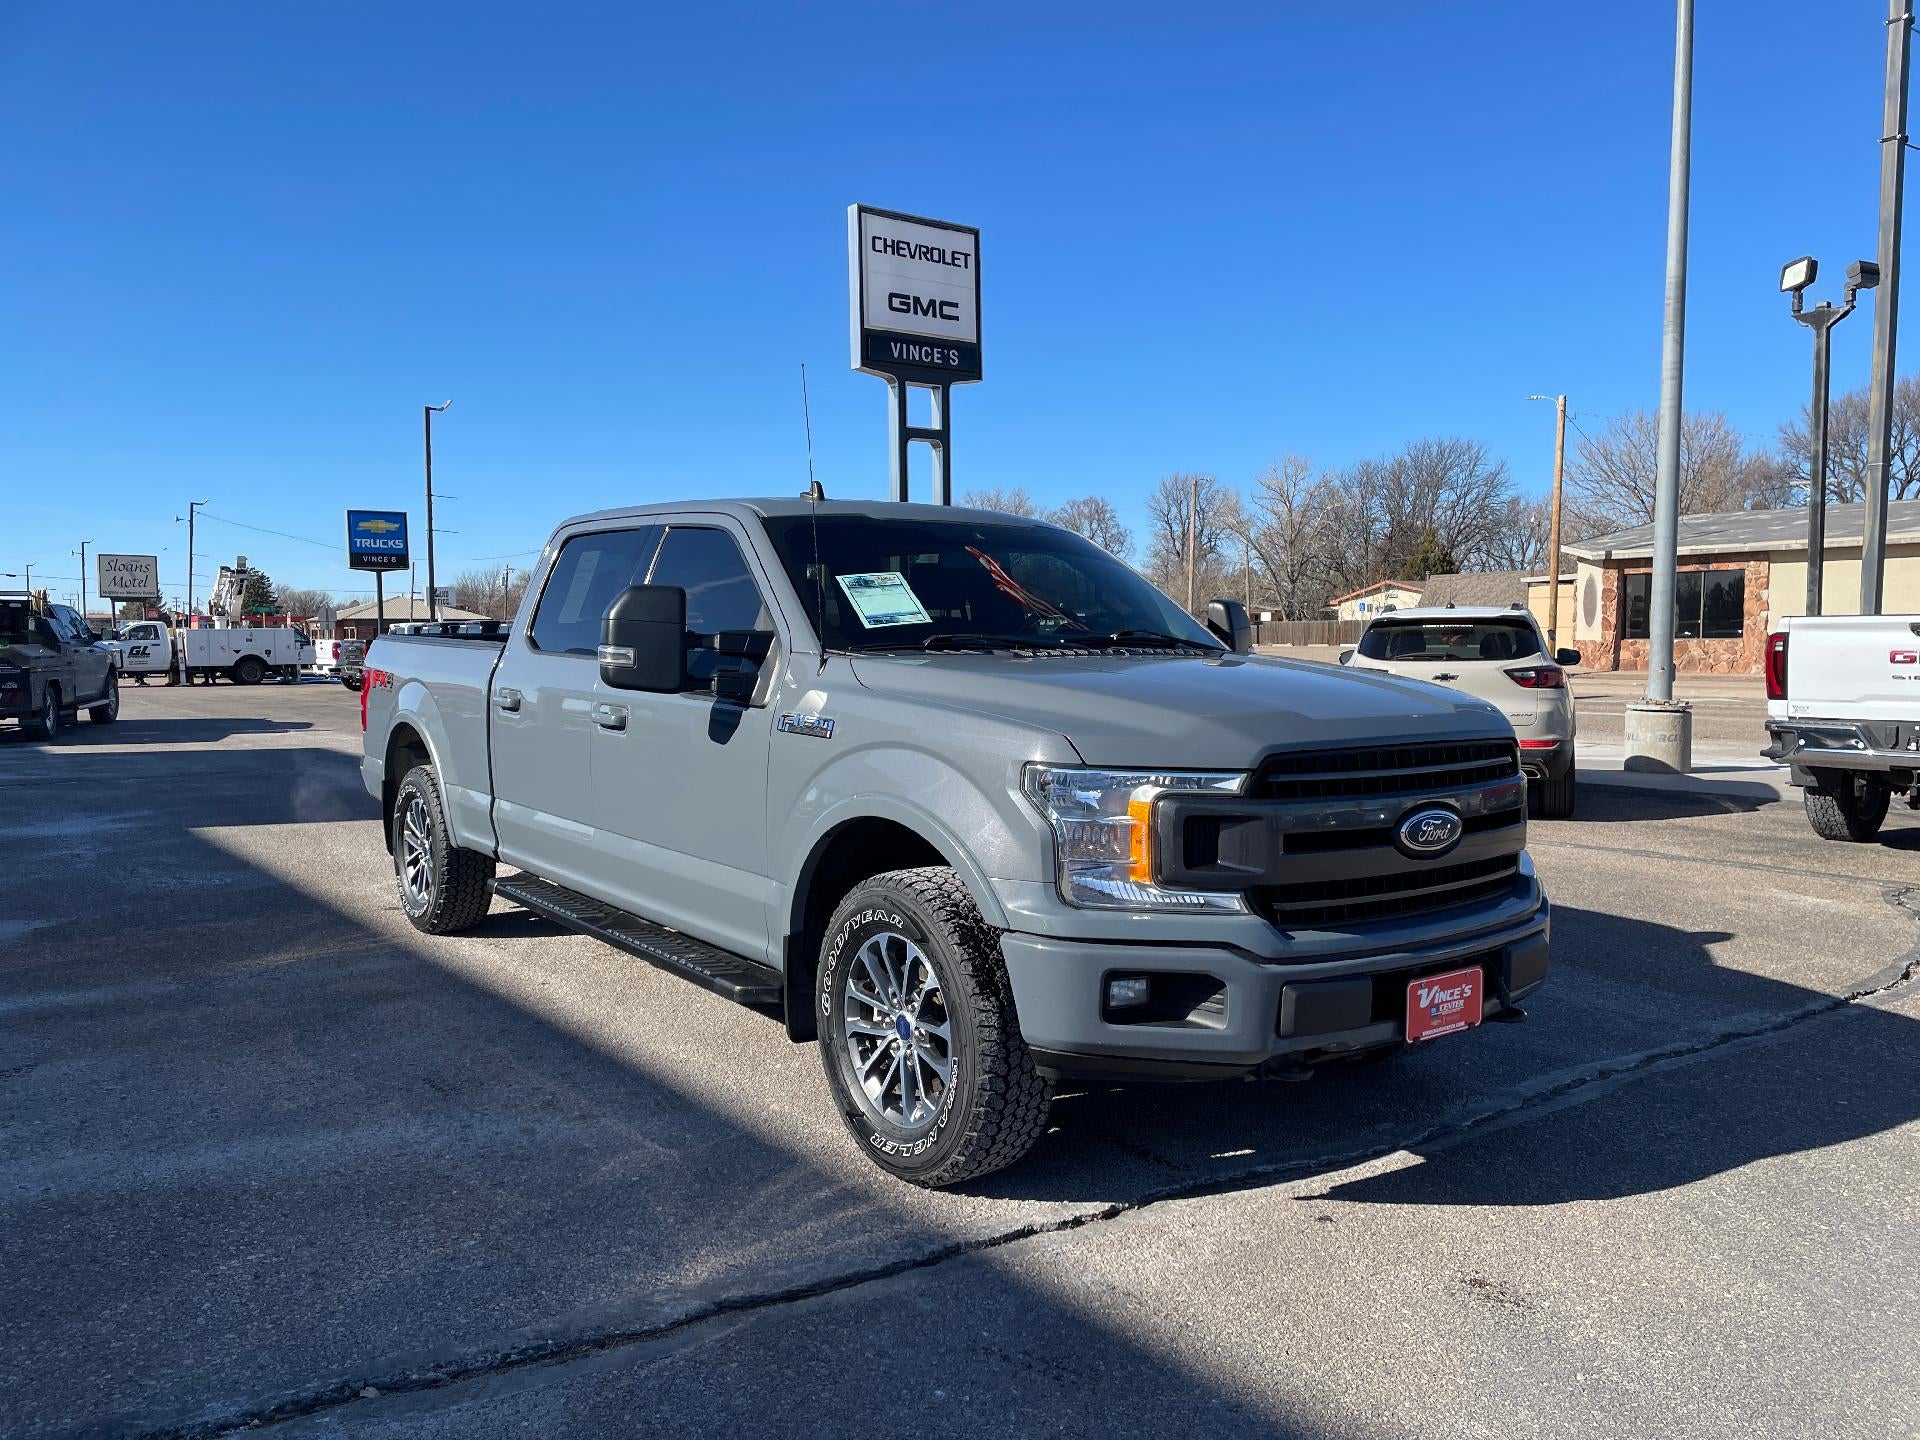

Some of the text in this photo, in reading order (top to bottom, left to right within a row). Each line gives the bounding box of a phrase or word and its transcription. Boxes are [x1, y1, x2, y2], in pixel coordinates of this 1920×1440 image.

[871, 235, 971, 269] CHEVROLET
[888, 292, 960, 321] GMC
[890, 341, 959, 366] VINCE'S
[353, 538, 404, 549] TRUCKS
[104, 558, 151, 572] Sloans
[362, 555, 397, 563] VINCE'S
[107, 574, 149, 588] Motel
[372, 669, 394, 689] FX4
[1418, 819, 1451, 842] Ford
[821, 909, 904, 1016] GOODYEAR
